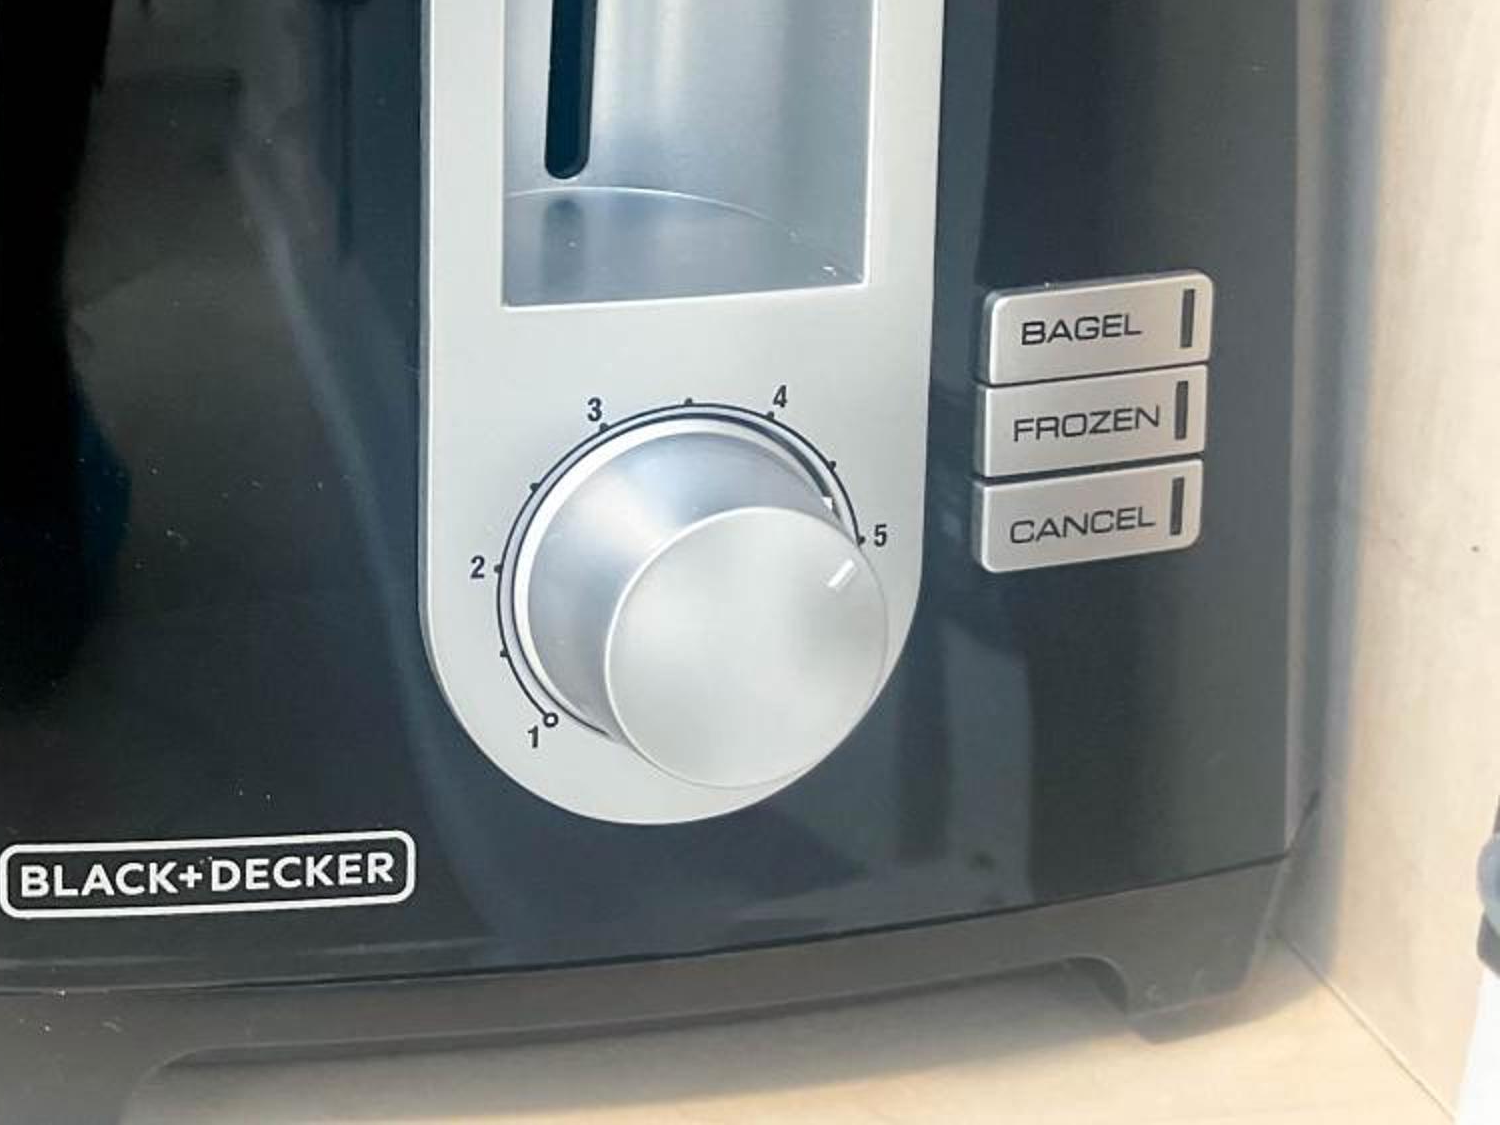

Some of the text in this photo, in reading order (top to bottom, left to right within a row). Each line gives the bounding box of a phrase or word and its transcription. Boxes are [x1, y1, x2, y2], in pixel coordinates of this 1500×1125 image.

[1021, 313, 1142, 346] BAGEL
[773, 384, 788, 408] 4
[587, 398, 602, 422] 3
[1013, 405, 1160, 442] FROZEN
[873, 524, 887, 548] 5
[1009, 506, 1156, 544] CANCEL
[470, 556, 485, 579] 2
[527, 725, 538, 748] 1
[19, 851, 395, 899] BLACK+DECKER
